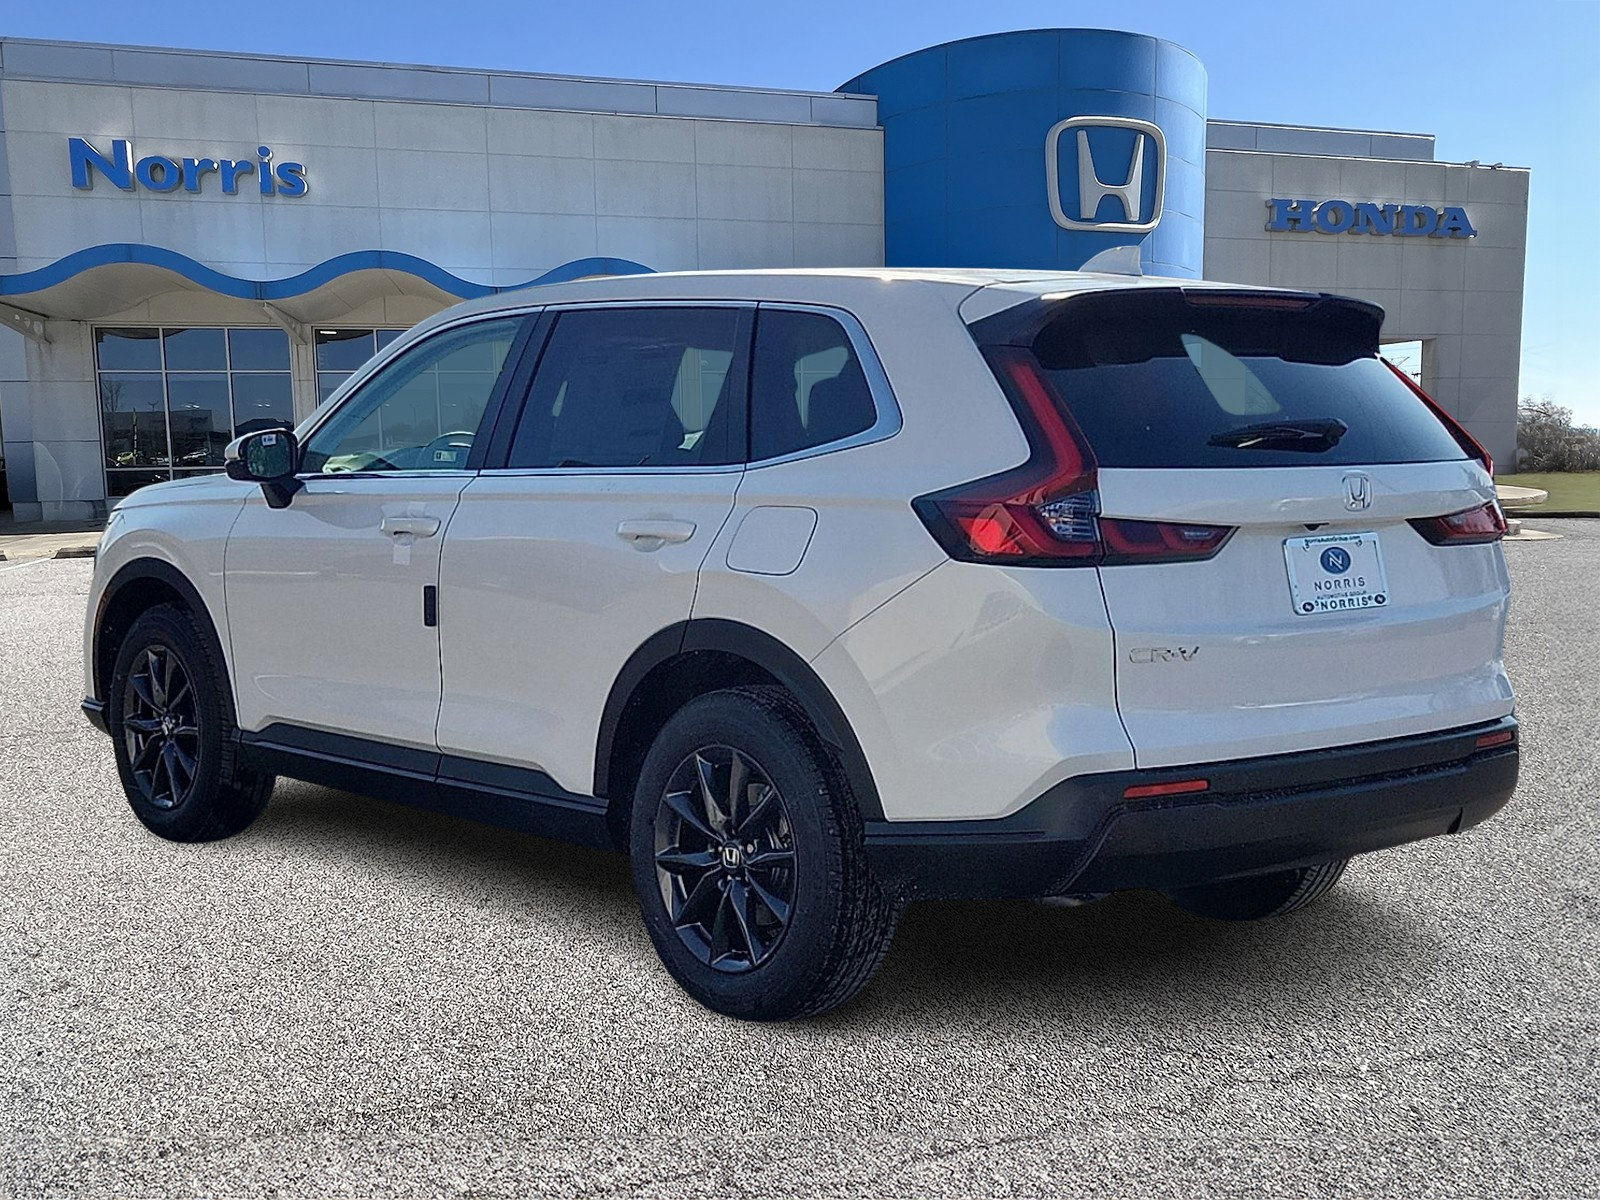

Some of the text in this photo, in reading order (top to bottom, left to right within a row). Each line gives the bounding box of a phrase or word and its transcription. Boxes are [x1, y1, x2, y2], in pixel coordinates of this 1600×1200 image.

[68, 137, 309, 198] Norris
[1266, 198, 1478, 239] HONDA
[1314, 577, 1366, 591] NORRIS
[1320, 597, 1368, 610] NORRIS
[1129, 646, 1199, 663] CR-V
